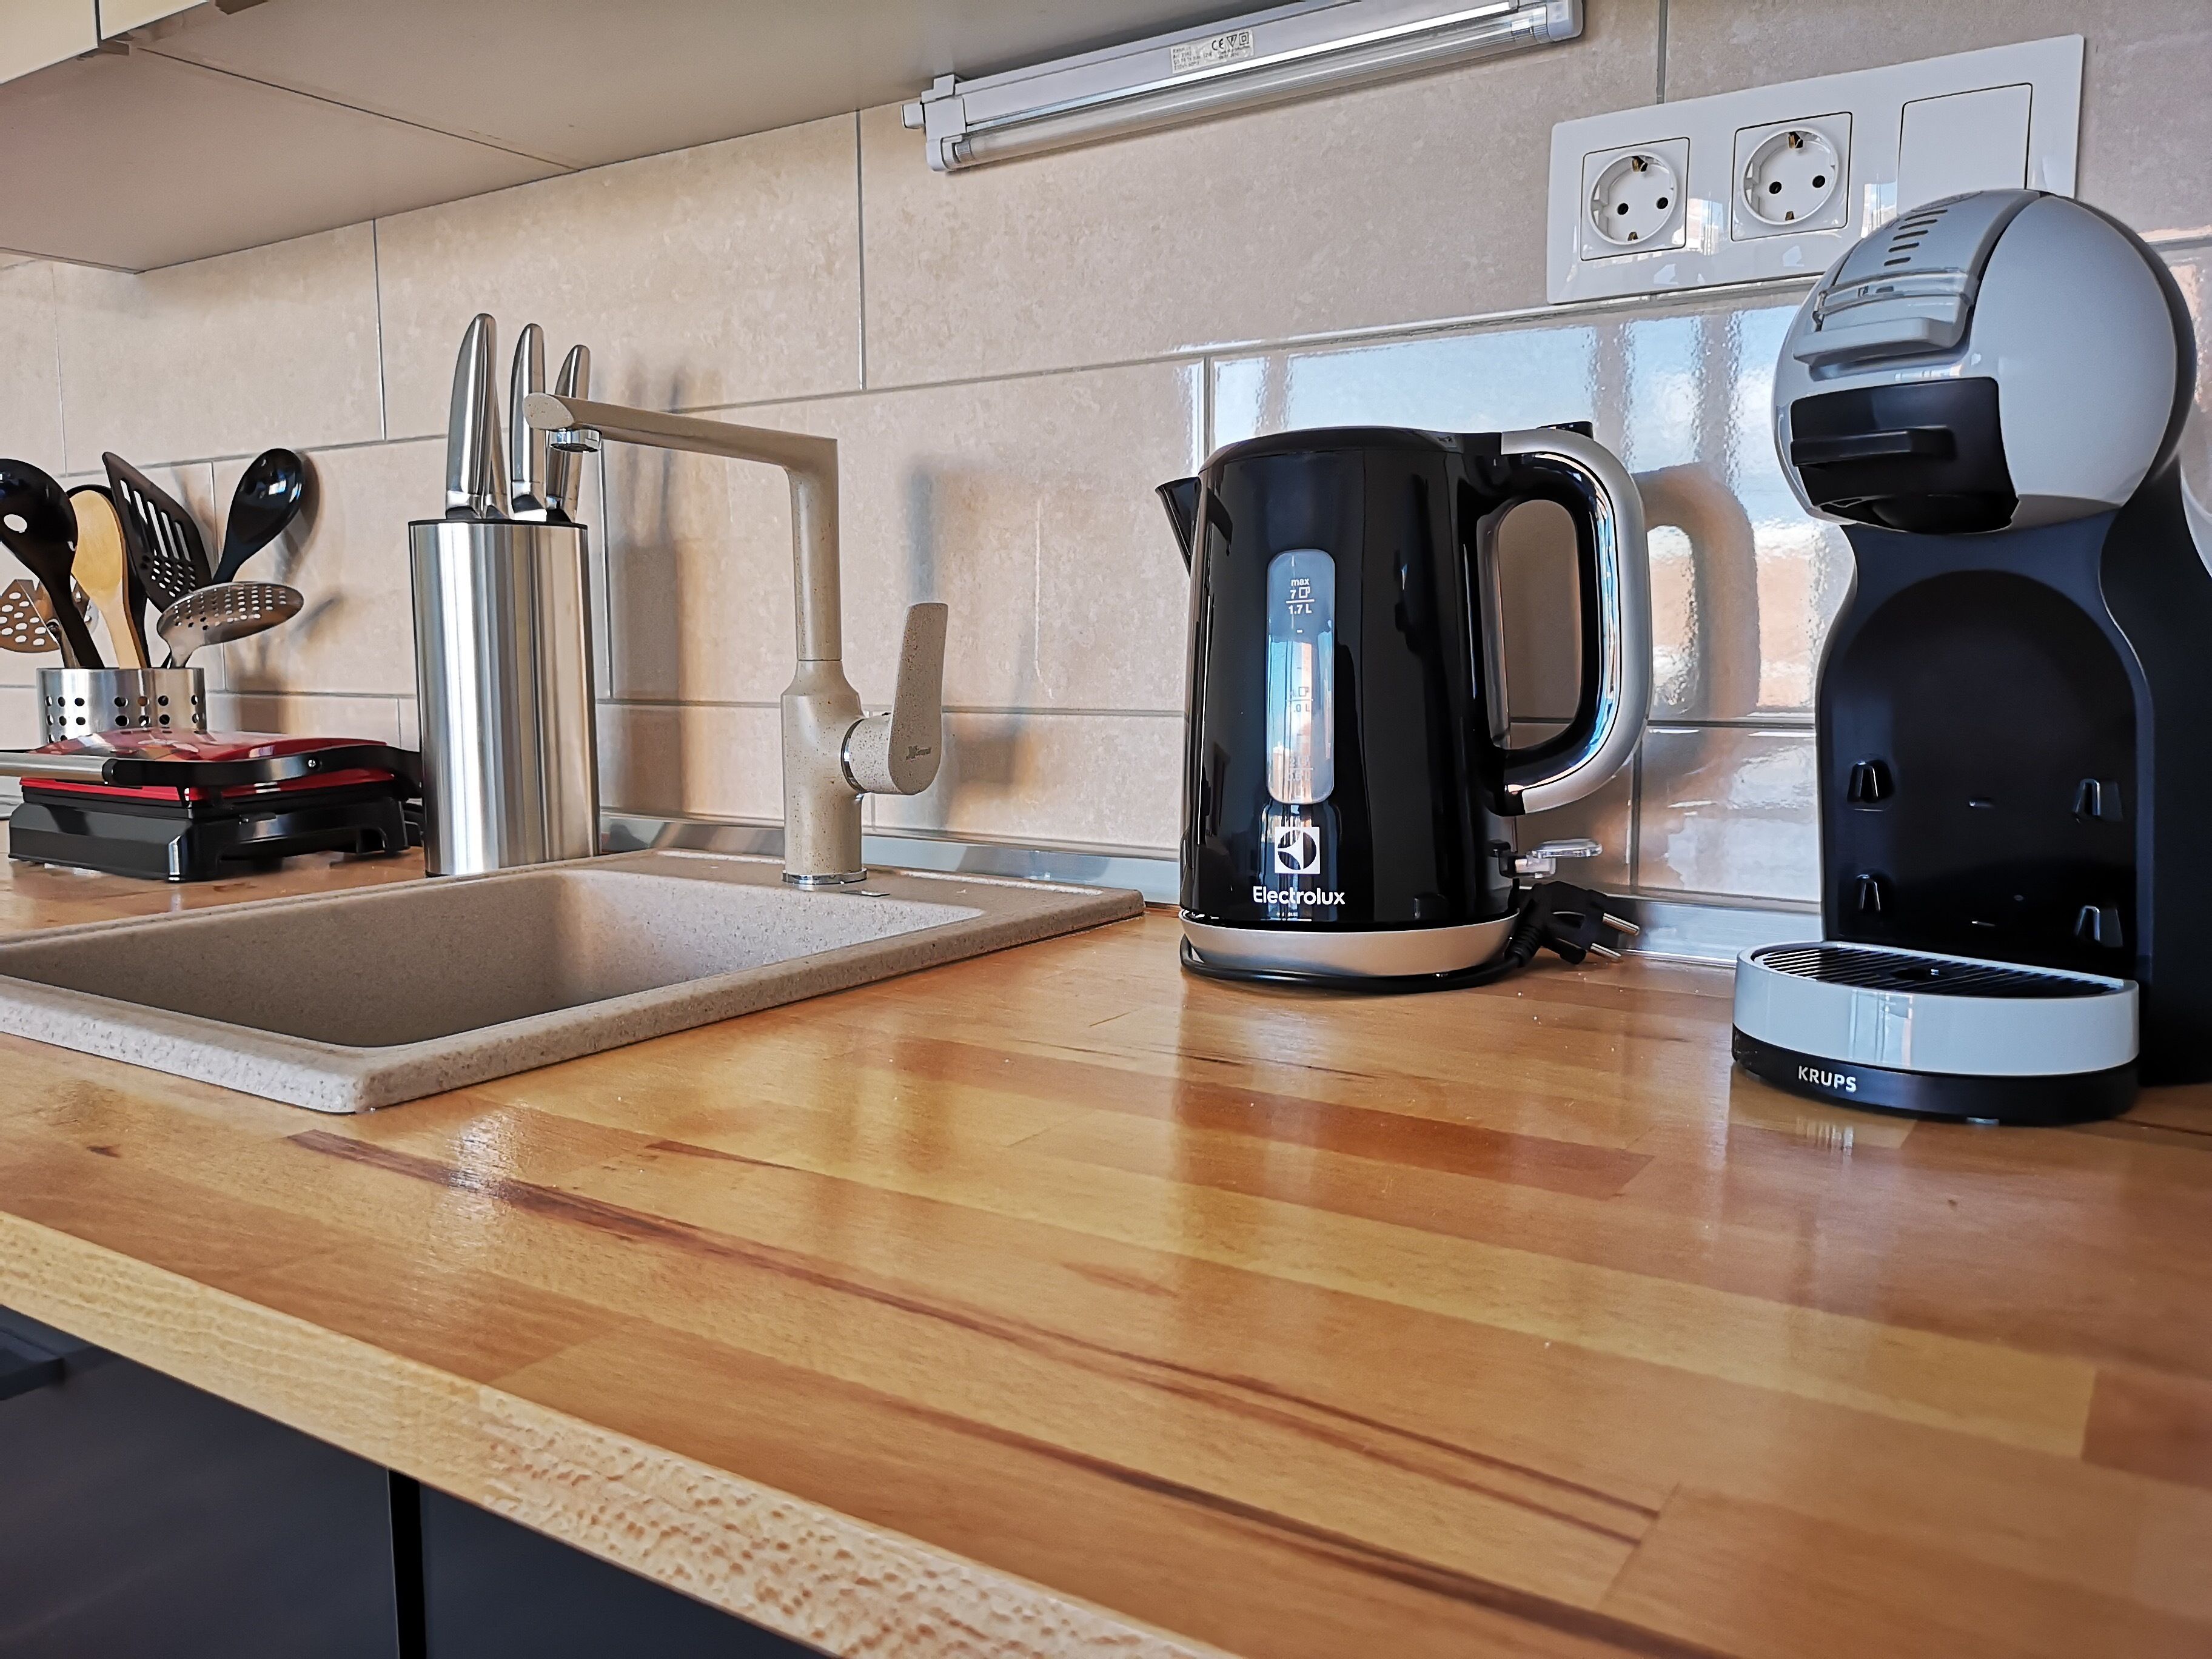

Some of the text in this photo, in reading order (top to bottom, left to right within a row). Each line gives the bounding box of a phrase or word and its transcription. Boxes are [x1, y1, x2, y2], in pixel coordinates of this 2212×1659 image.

[1291, 578, 1310, 586] max
[1290, 589, 1296, 599] 7
[1289, 603, 1312, 615] 1.7 L
[1253, 886, 1346, 905] Electrolux
[1798, 1065, 1857, 1093] KRUPS
